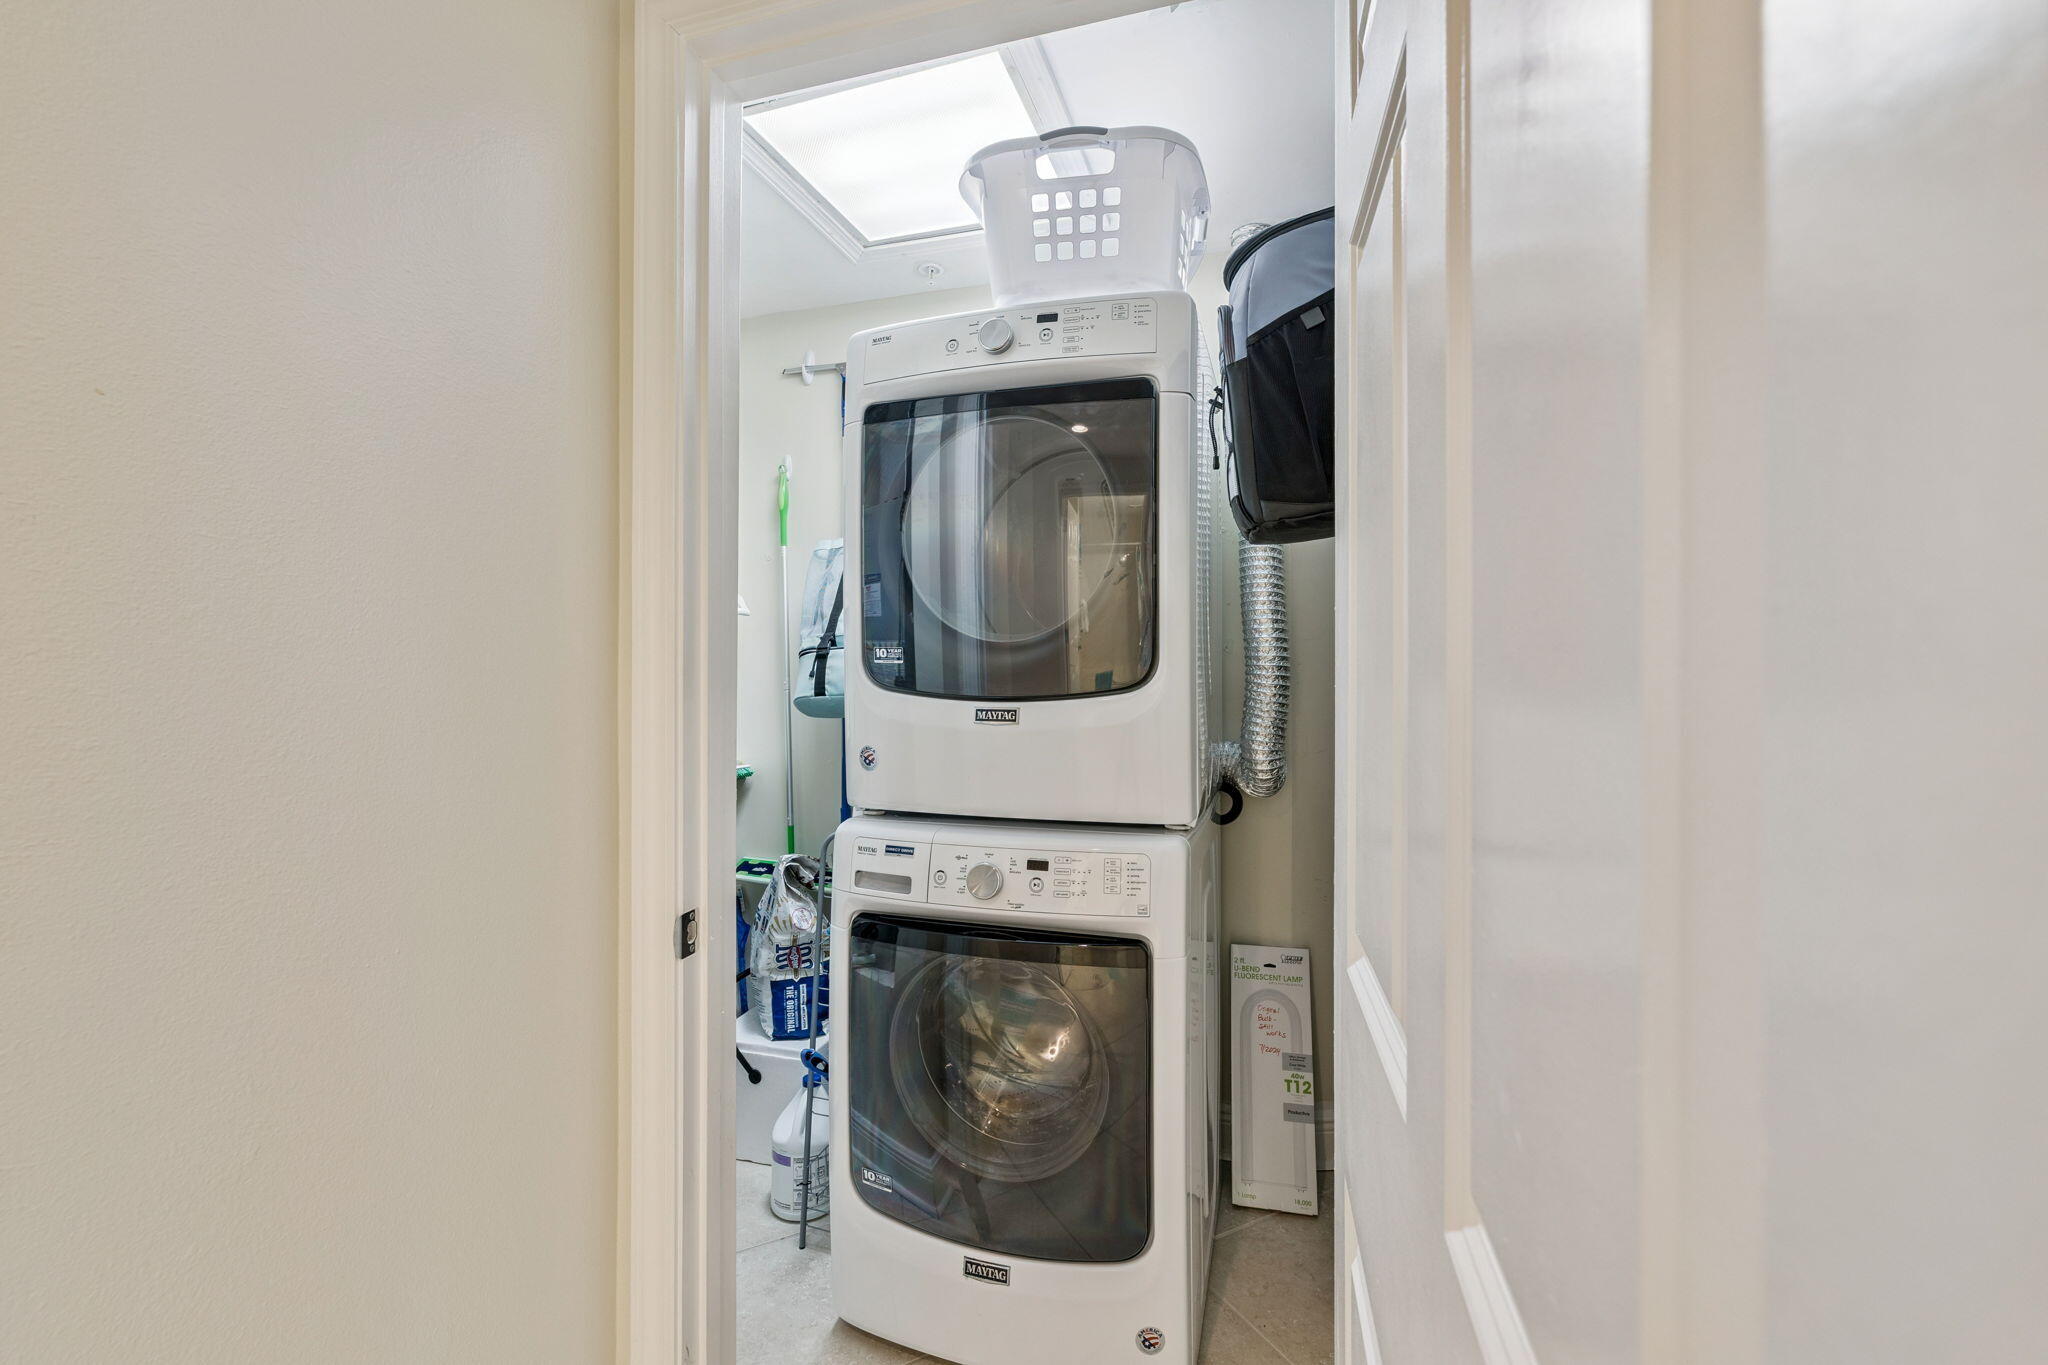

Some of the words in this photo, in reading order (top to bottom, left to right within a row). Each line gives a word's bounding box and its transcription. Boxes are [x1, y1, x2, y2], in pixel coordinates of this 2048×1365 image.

[876, 648, 887, 658] 10
[977, 711, 1016, 720] MAYTAG
[1234, 965, 1261, 973] U-BEND
[1234, 972, 1281, 982] FLUORESCENT
[1283, 975, 1304, 983] LAMP
[786, 985, 794, 999] THE
[786, 1000, 796, 1034] ORIGINAL
[1266, 1030, 1287, 1039] works
[1284, 1079, 1312, 1095] T12
[863, 1169, 876, 1181] 10
[966, 1263, 1006, 1281] MAYTAG
[1138, 1327, 1163, 1339] AMERICA
